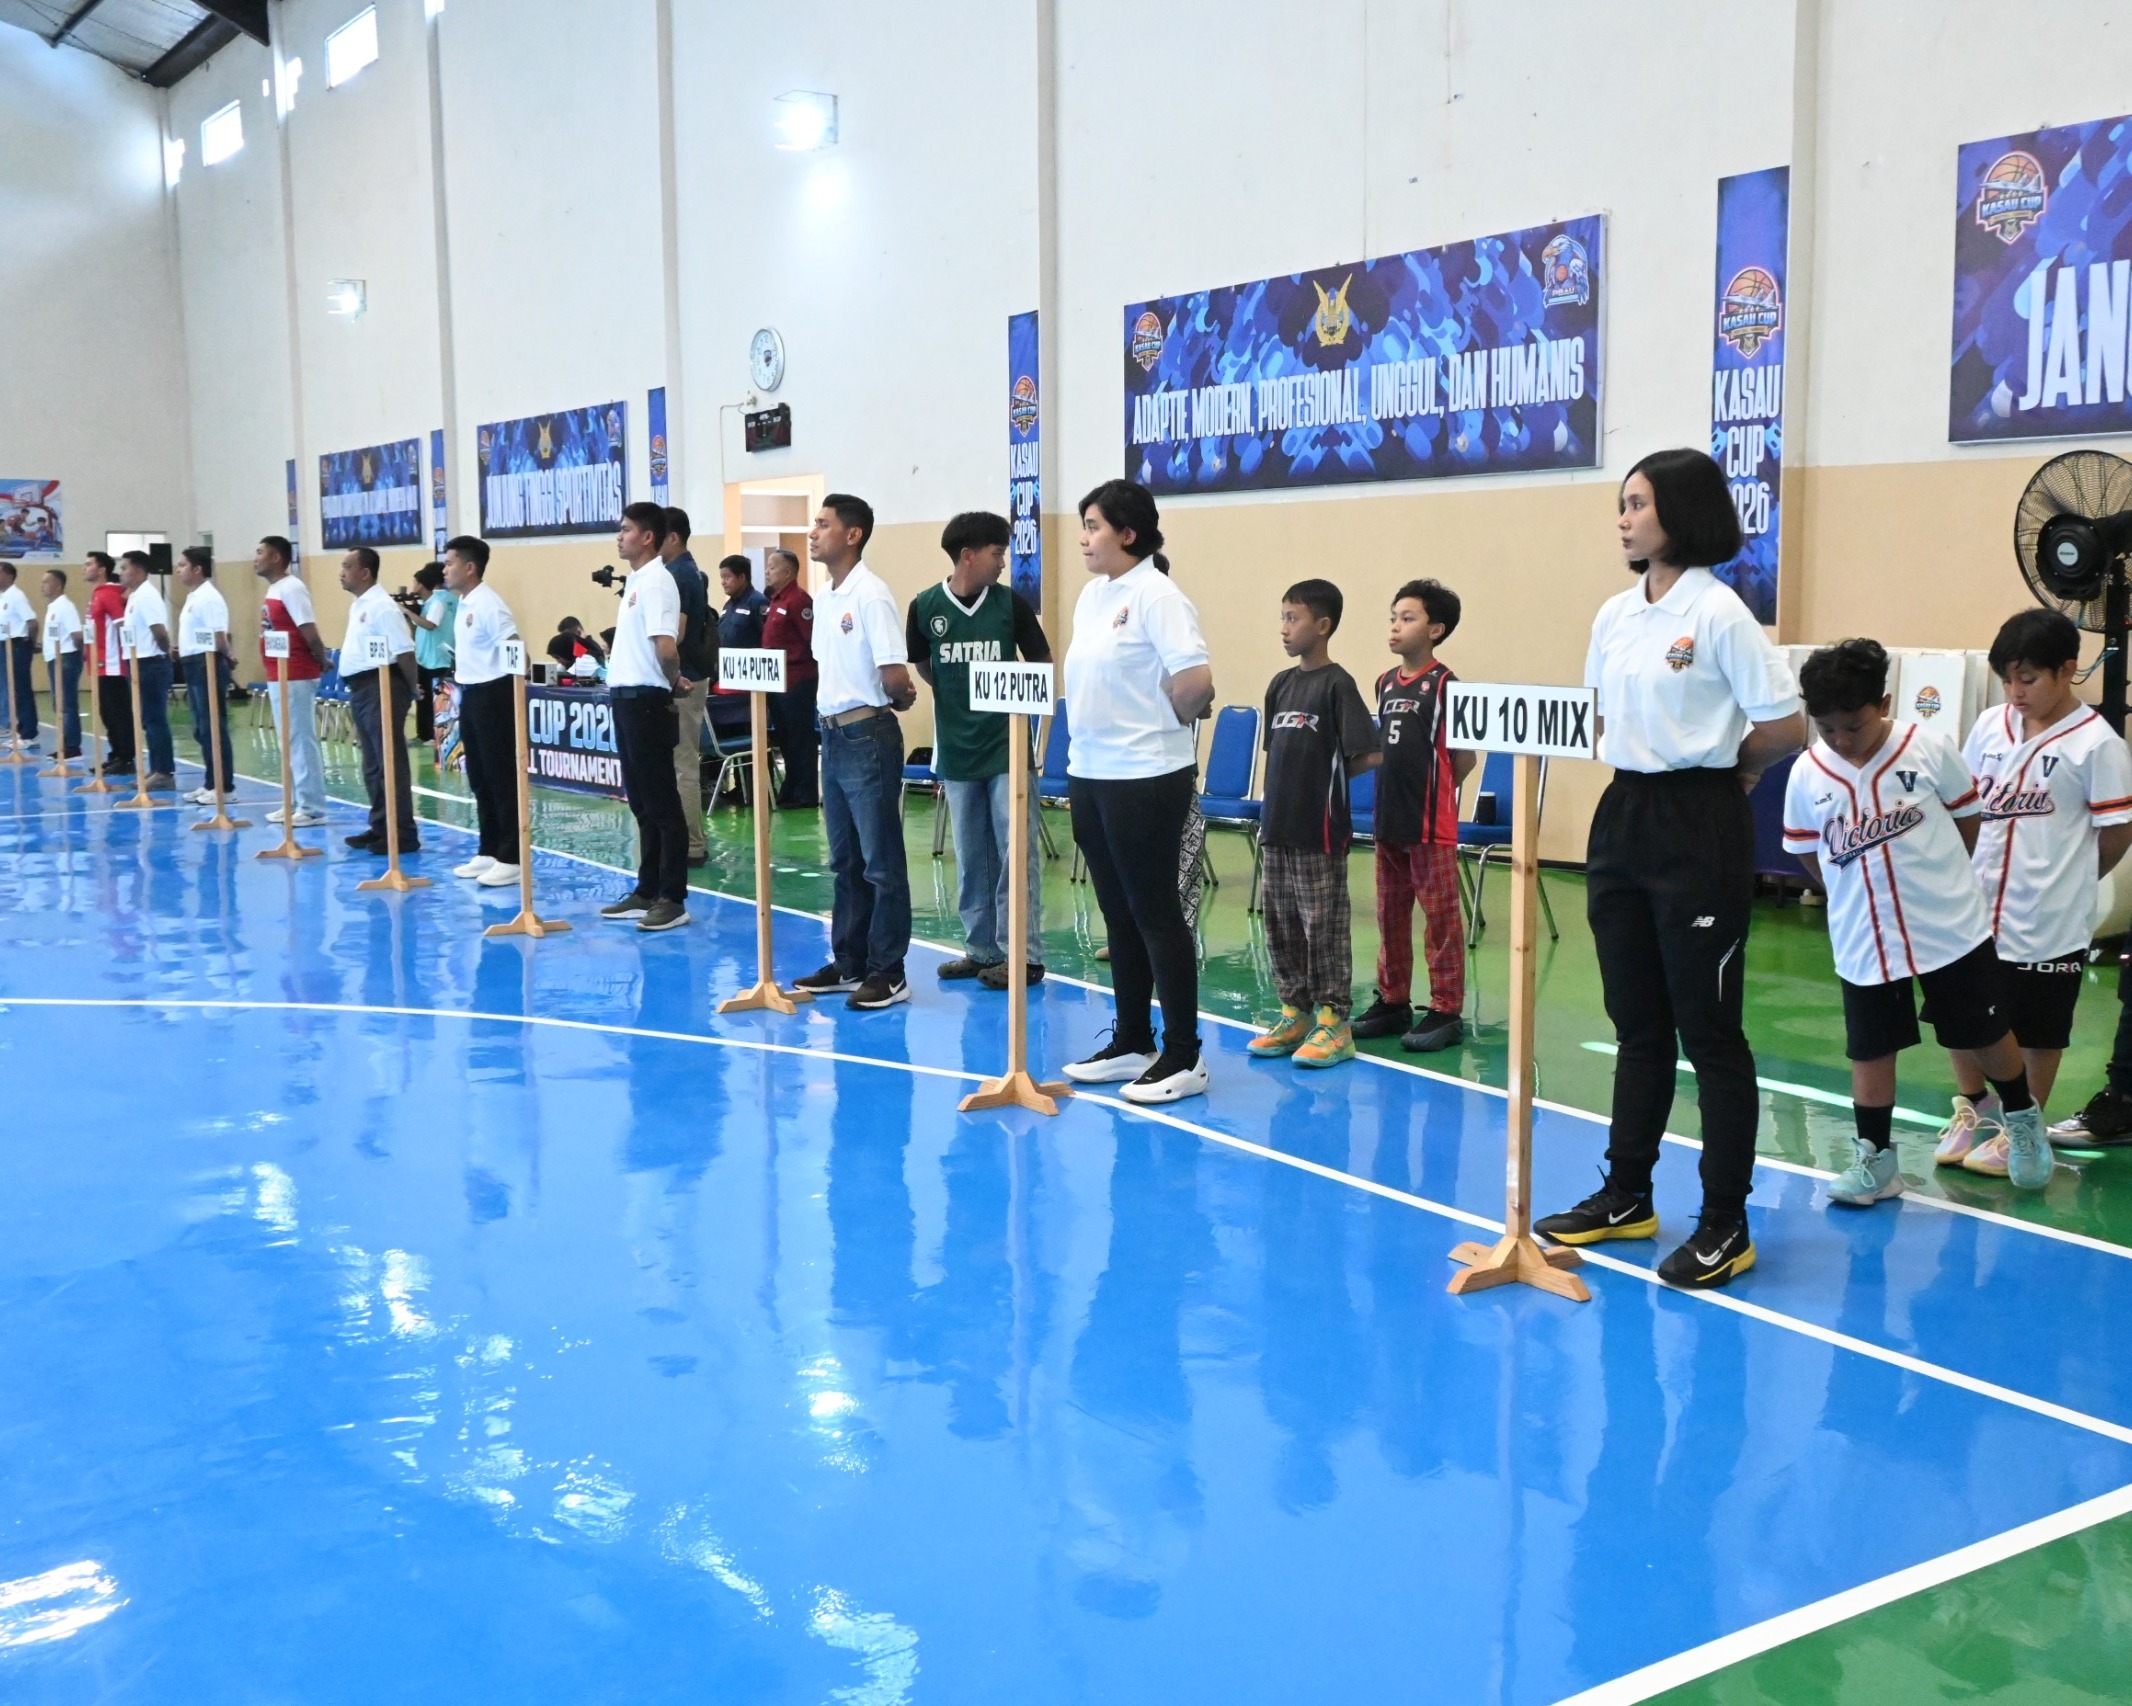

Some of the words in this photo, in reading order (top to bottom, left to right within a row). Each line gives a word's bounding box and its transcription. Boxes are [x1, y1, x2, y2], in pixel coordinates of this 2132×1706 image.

[1723, 313, 1757, 331] KASAU
[1758, 311, 1777, 325] CUP
[2019, 259, 2132, 411] JAN
[1192, 381, 1255, 438] MODERN,
[1258, 367, 1367, 432] PROFESIONAL,
[1371, 357, 1444, 420] UNGGUL,
[1449, 350, 1487, 412] DAN
[1491, 336, 1585, 408] HUMANIS
[1714, 365, 1782, 422] KASAU
[1010, 442, 1038, 478] KASAU
[1726, 425, 1765, 478] CUP
[1017, 481, 1033, 516] CUP
[1729, 482, 1770, 534] 026
[1014, 519, 1036, 554] 2026
[723, 656, 735, 680] KU
[738, 656, 748, 680] 14
[750, 657, 780, 681] PUTRA
[940, 641, 1001, 663] SATRIA
[975, 671, 990, 699] KU
[994, 671, 1006, 700] 12
[1010, 673, 1048, 702] PUTRA
[529, 699, 566, 745] CUP
[1388, 720, 1401, 744] 5
[1453, 695, 1488, 741] KU
[1499, 697, 1528, 743] 10
[1538, 699, 1589, 748] MIX
[538, 749, 622, 787] TOURNAMENT
[1896, 771, 1918, 792] V
[2042, 755, 2059, 777] V
[1823, 799, 1925, 856] Victoria
